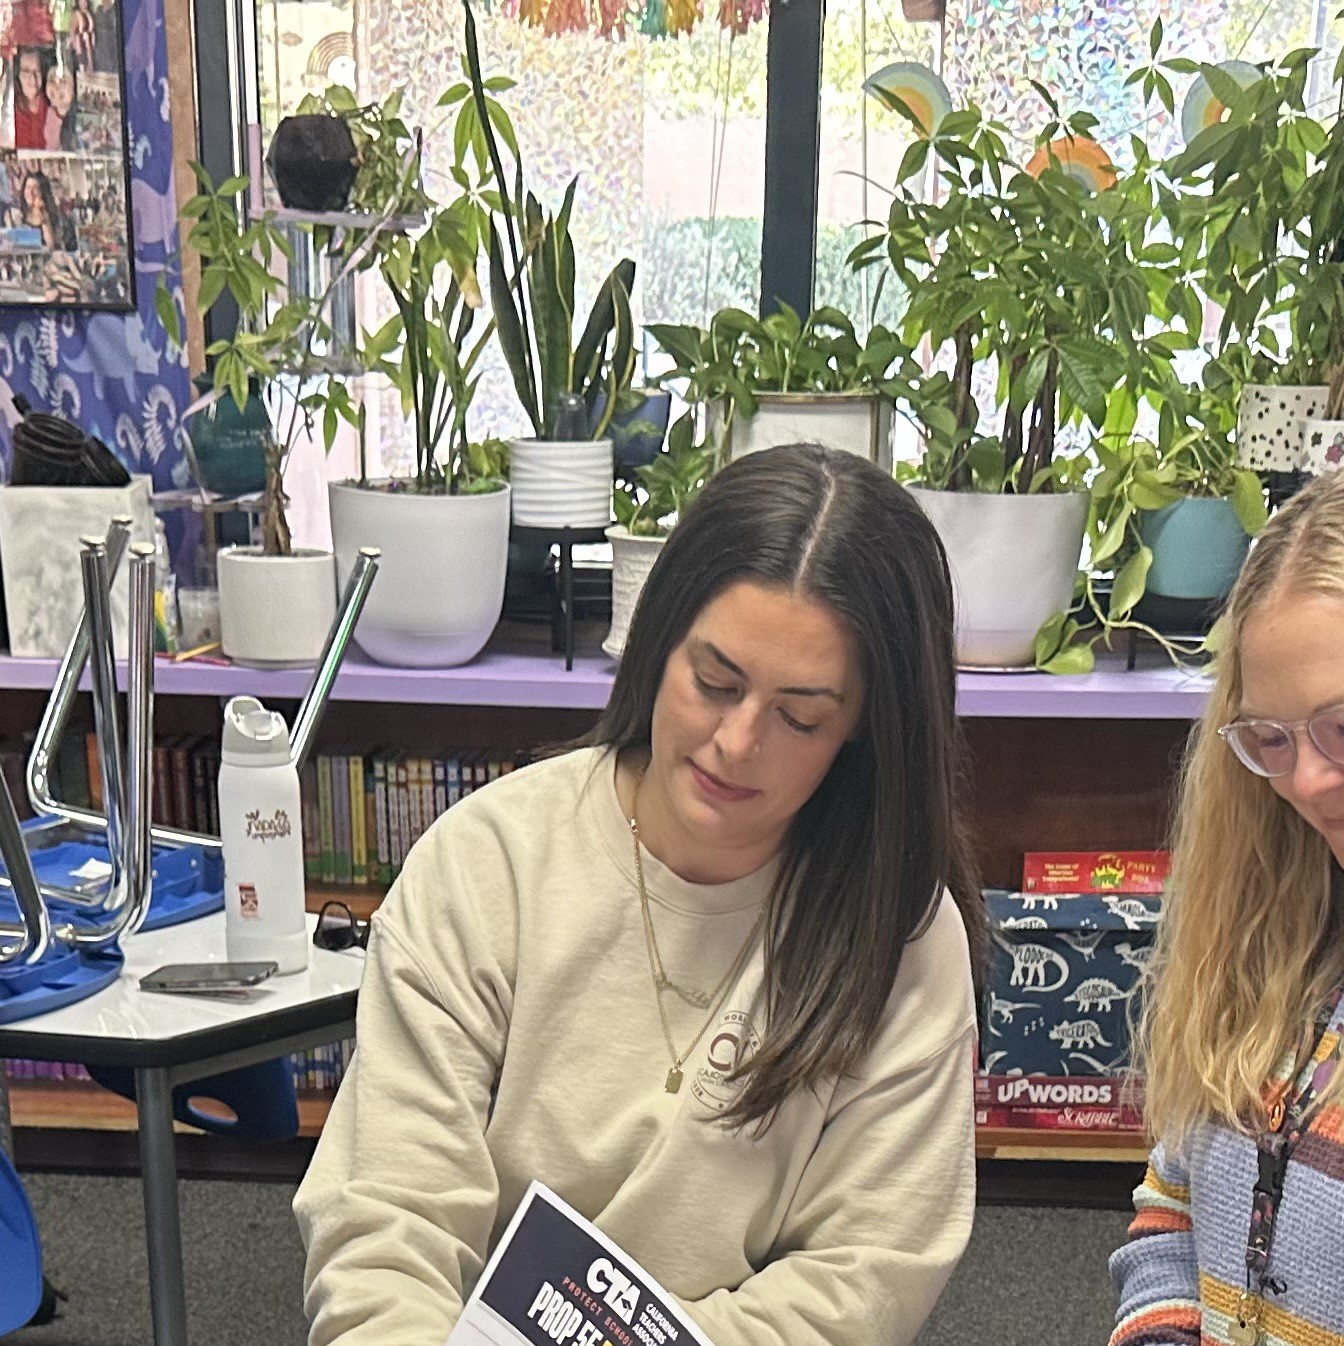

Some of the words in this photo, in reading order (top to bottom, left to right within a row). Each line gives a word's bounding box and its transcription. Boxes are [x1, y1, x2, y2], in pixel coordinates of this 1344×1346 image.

[997, 1078, 1112, 1104] UPWORDS
[560, 1275, 604, 1317] PROTECT
[586, 1257, 641, 1326] CTA
[526, 1281, 584, 1346] PROP
[638, 1312, 667, 1345] TEACHERS
[645, 1303, 679, 1342] CALIFORNIA
